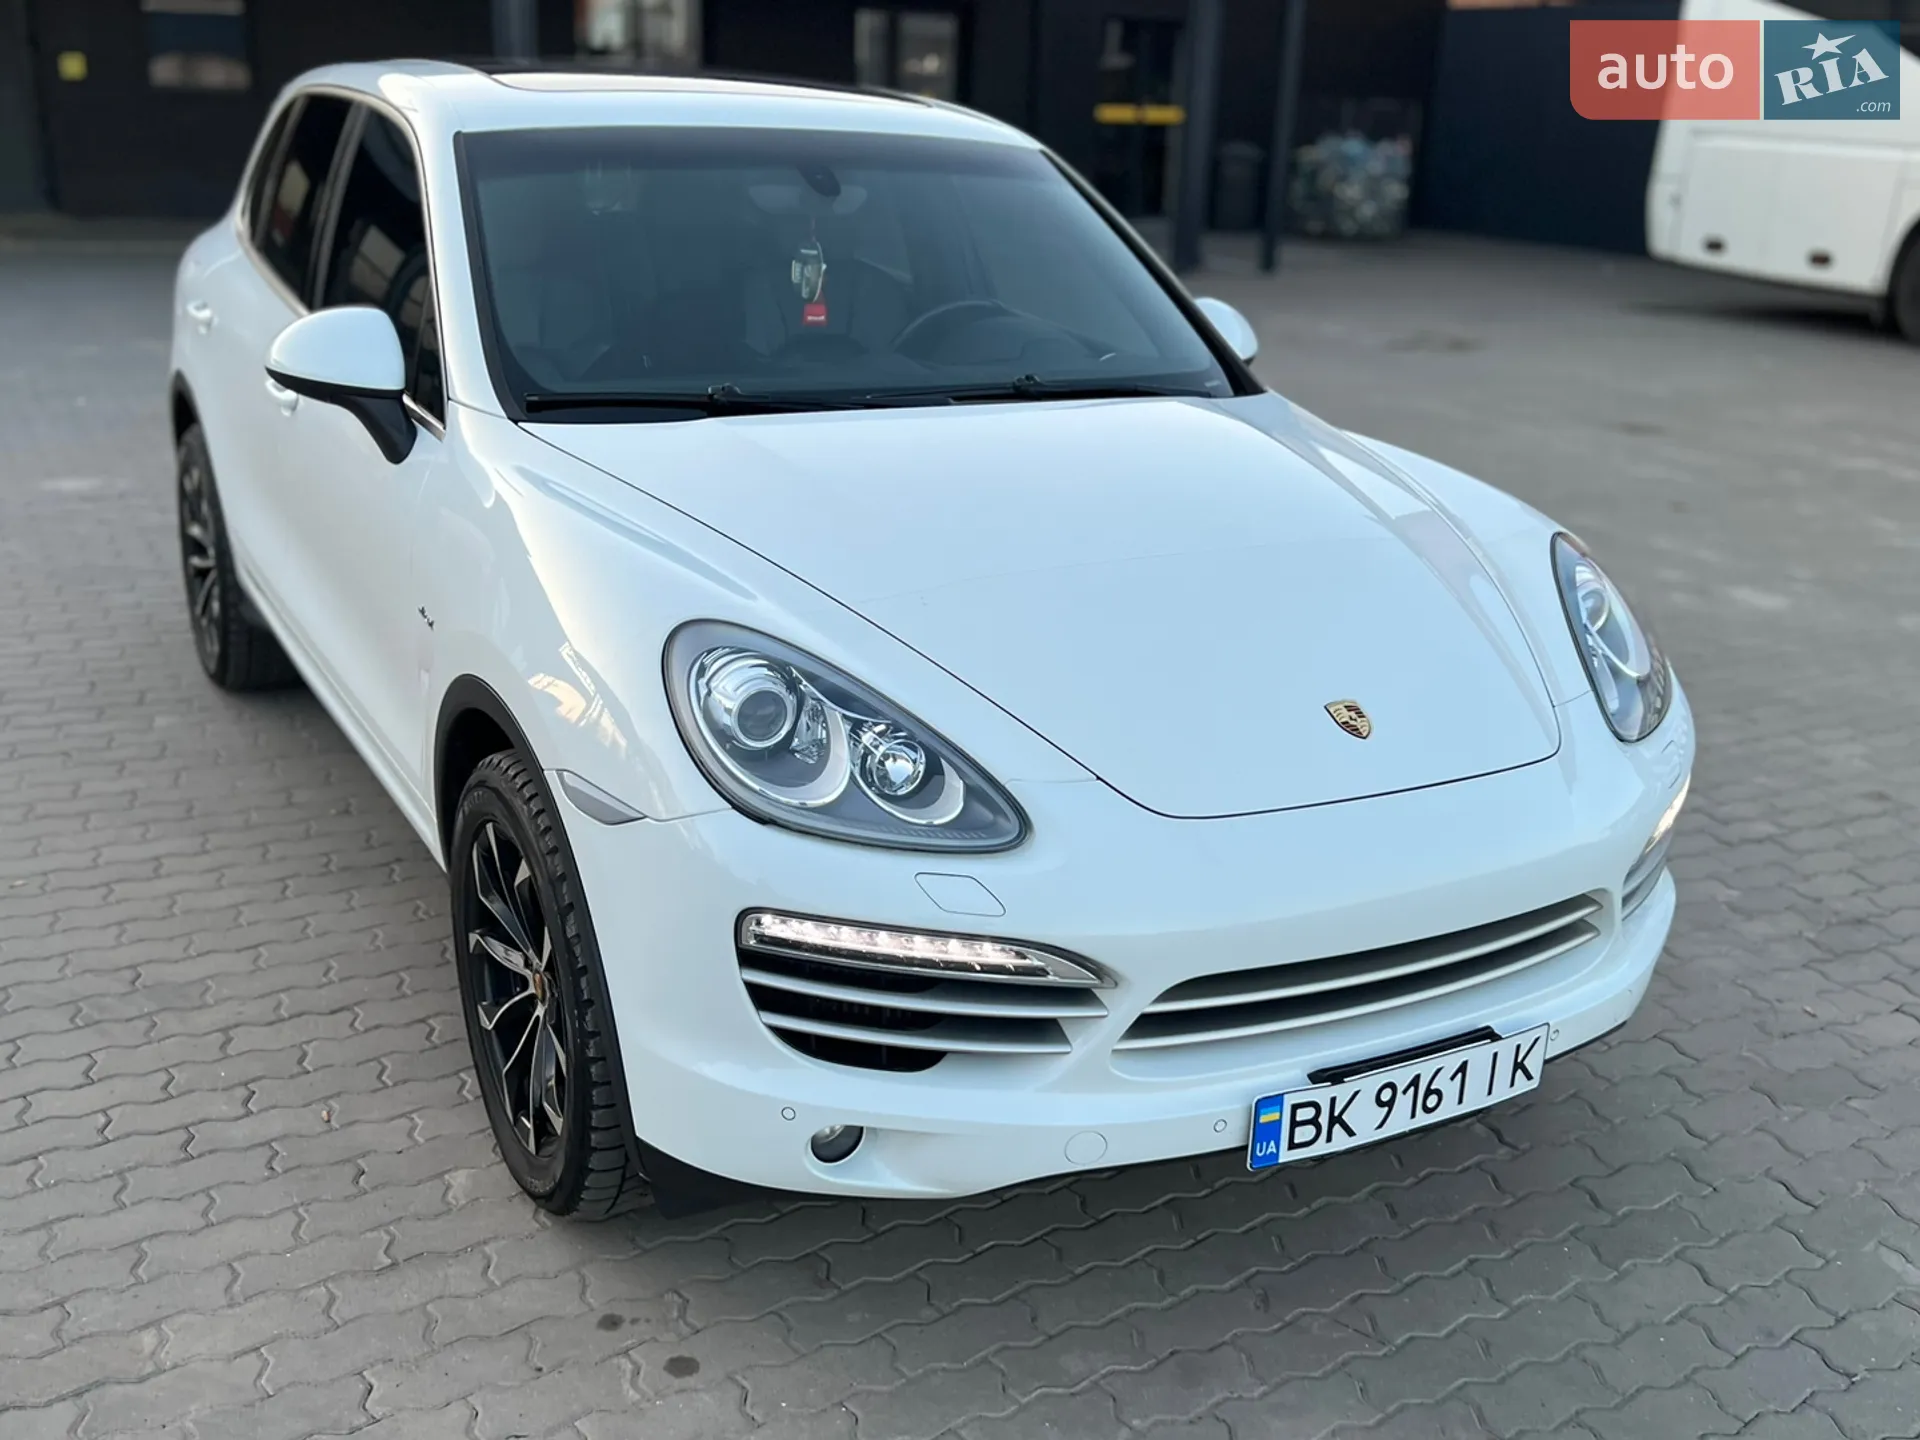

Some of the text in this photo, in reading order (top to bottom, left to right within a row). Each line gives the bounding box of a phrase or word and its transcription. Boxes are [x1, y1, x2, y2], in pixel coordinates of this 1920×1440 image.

[1287, 1036, 1541, 1151] BK 9161 IK
[1256, 1140, 1277, 1156] UA
